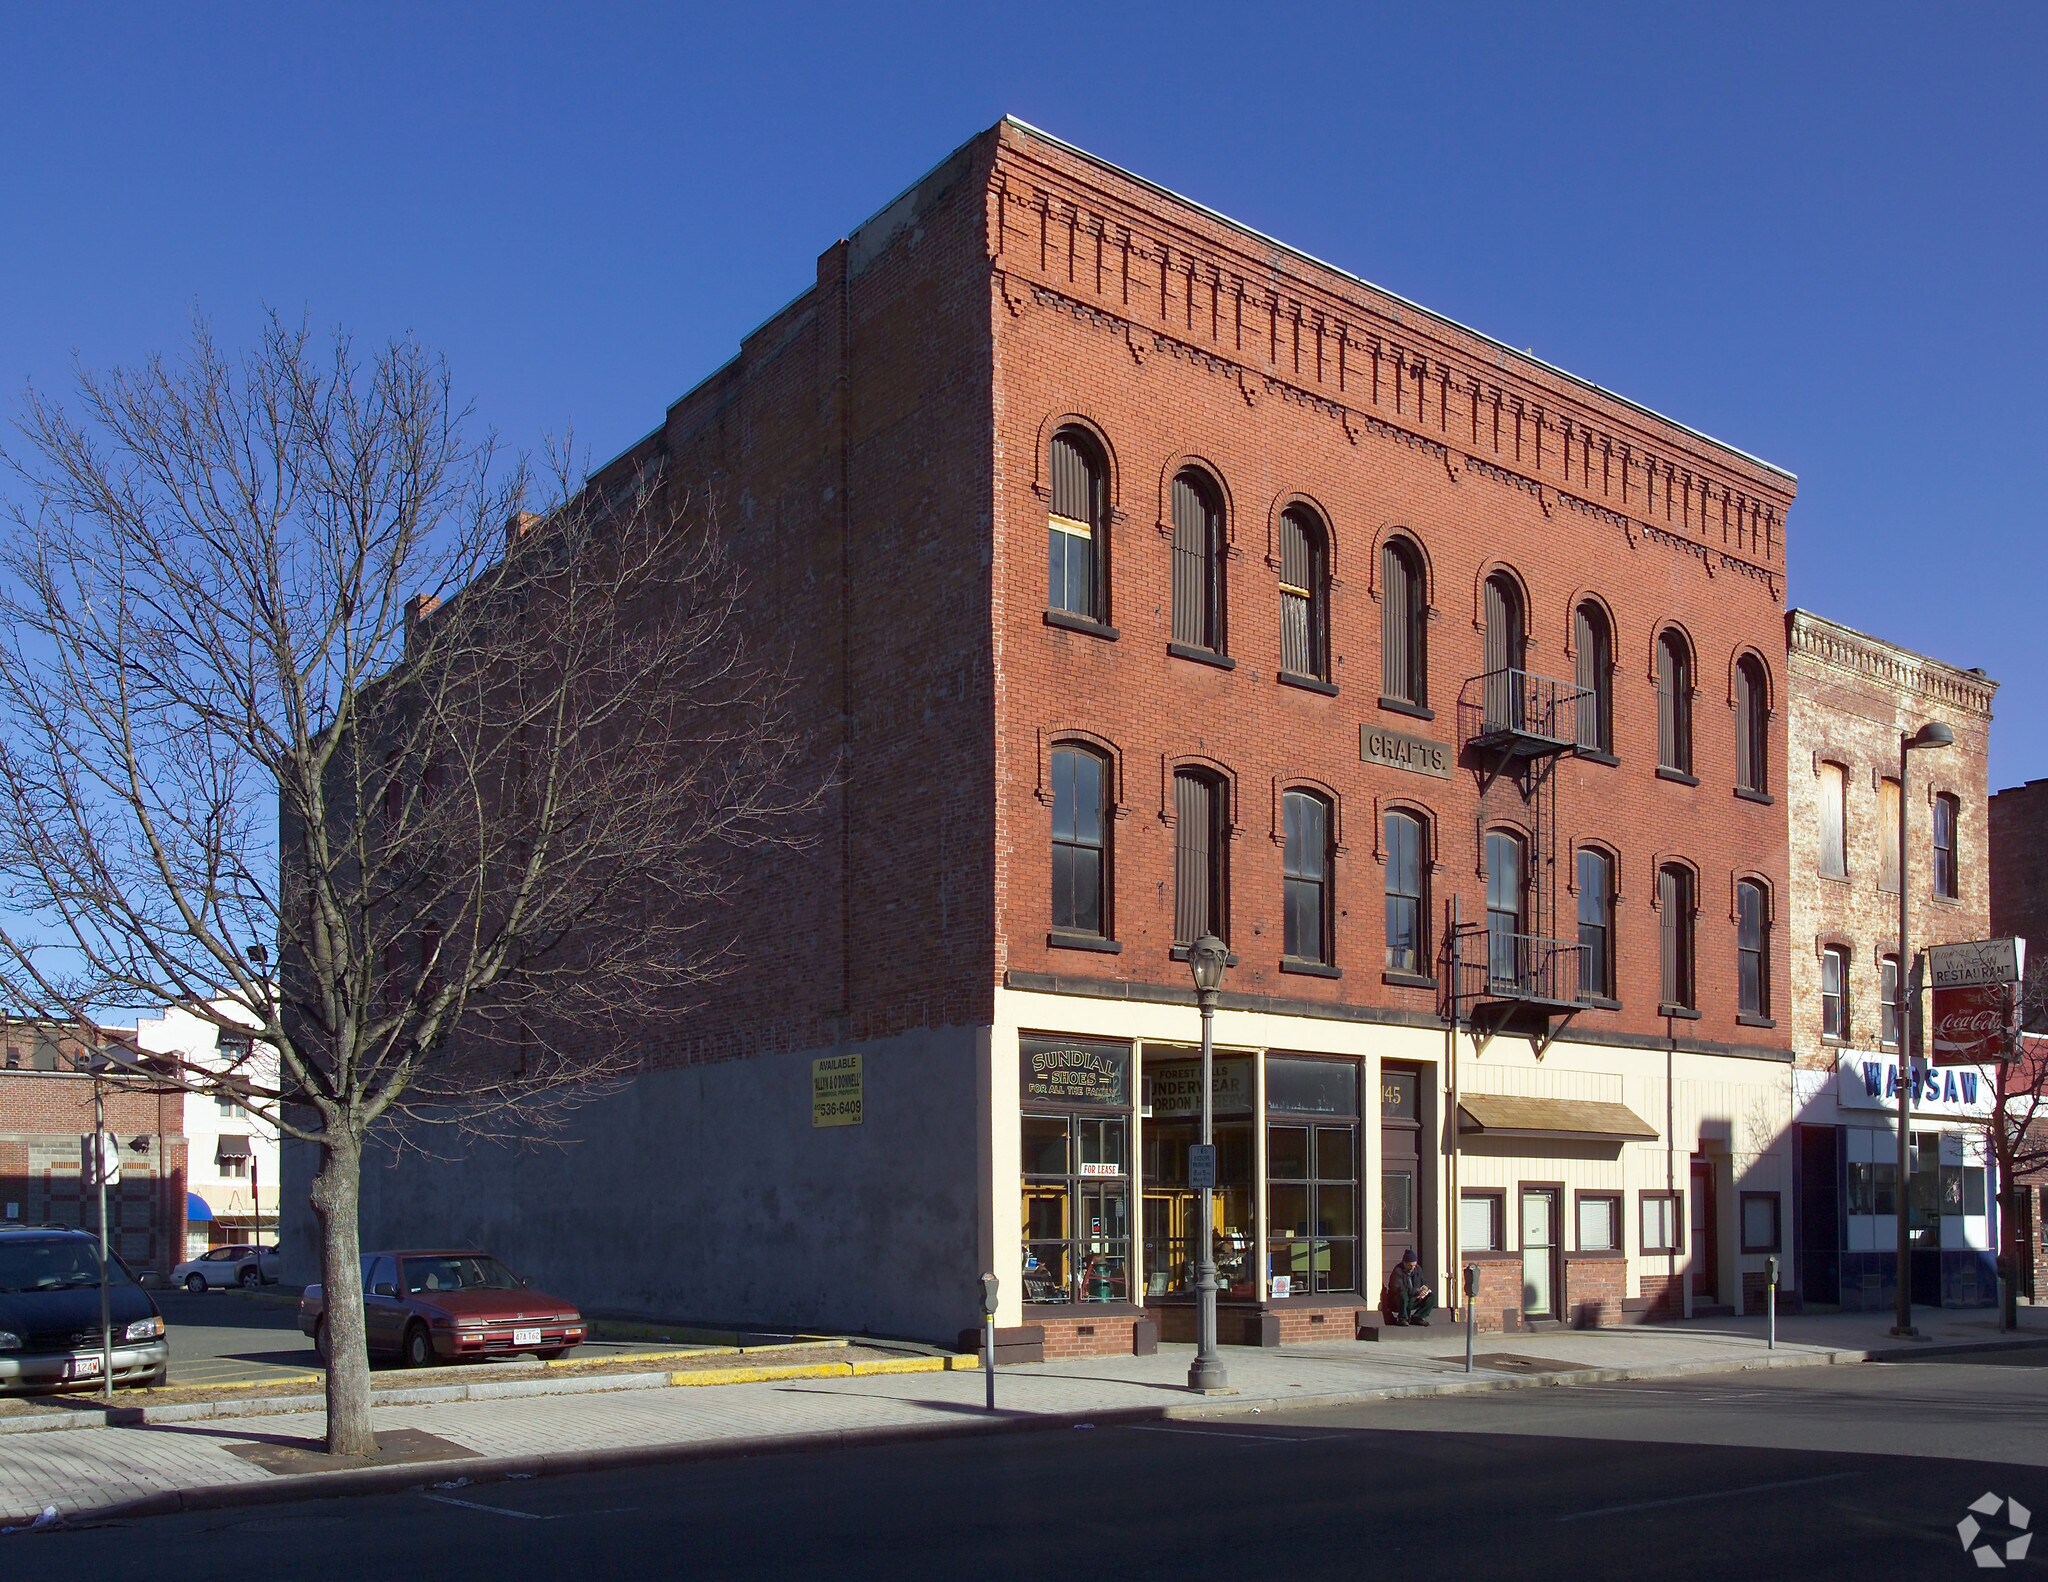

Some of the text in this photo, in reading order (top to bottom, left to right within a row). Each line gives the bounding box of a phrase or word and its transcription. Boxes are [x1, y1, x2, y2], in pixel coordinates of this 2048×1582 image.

[819, 1057, 856, 1071] AVAILABLE
[1032, 1050, 1115, 1078] SUNDIAL
[1051, 1071, 1097, 1086] SHOES
[1160, 1066, 1228, 1079] FOREST LLS
[1028, 1083, 1047, 1094] FOR
[1048, 1085, 1065, 1095] ALL
[1067, 1086, 1084, 1095] THE
[1152, 1079, 1240, 1096] UNDEREAR
[1152, 1097, 1191, 1112] ORDON
[1084, 1164, 1116, 1174] FOR LEASE
